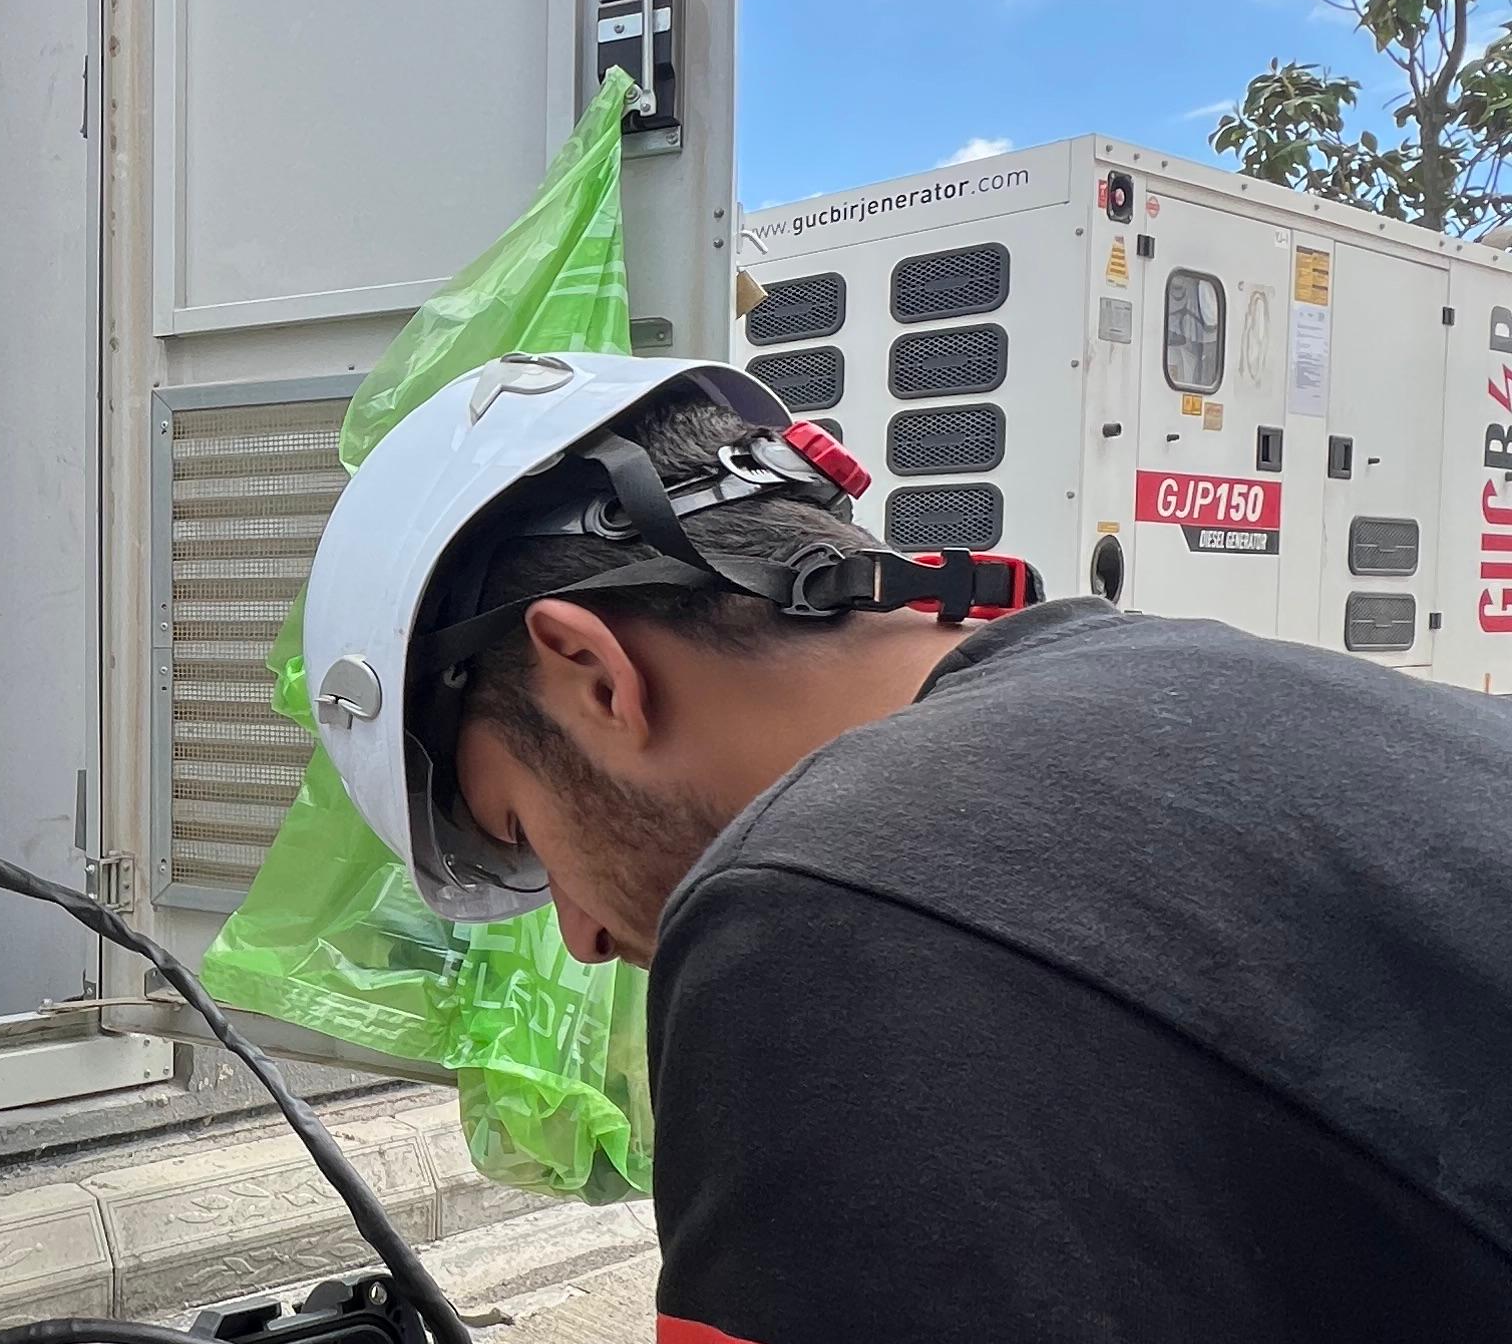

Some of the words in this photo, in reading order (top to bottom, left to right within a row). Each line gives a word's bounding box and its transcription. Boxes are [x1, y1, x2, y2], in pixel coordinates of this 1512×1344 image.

[1157, 478, 1264, 522] GJP150
[1199, 529, 1225, 549] DIESEL
[1225, 531, 1268, 550] GENERATOR
